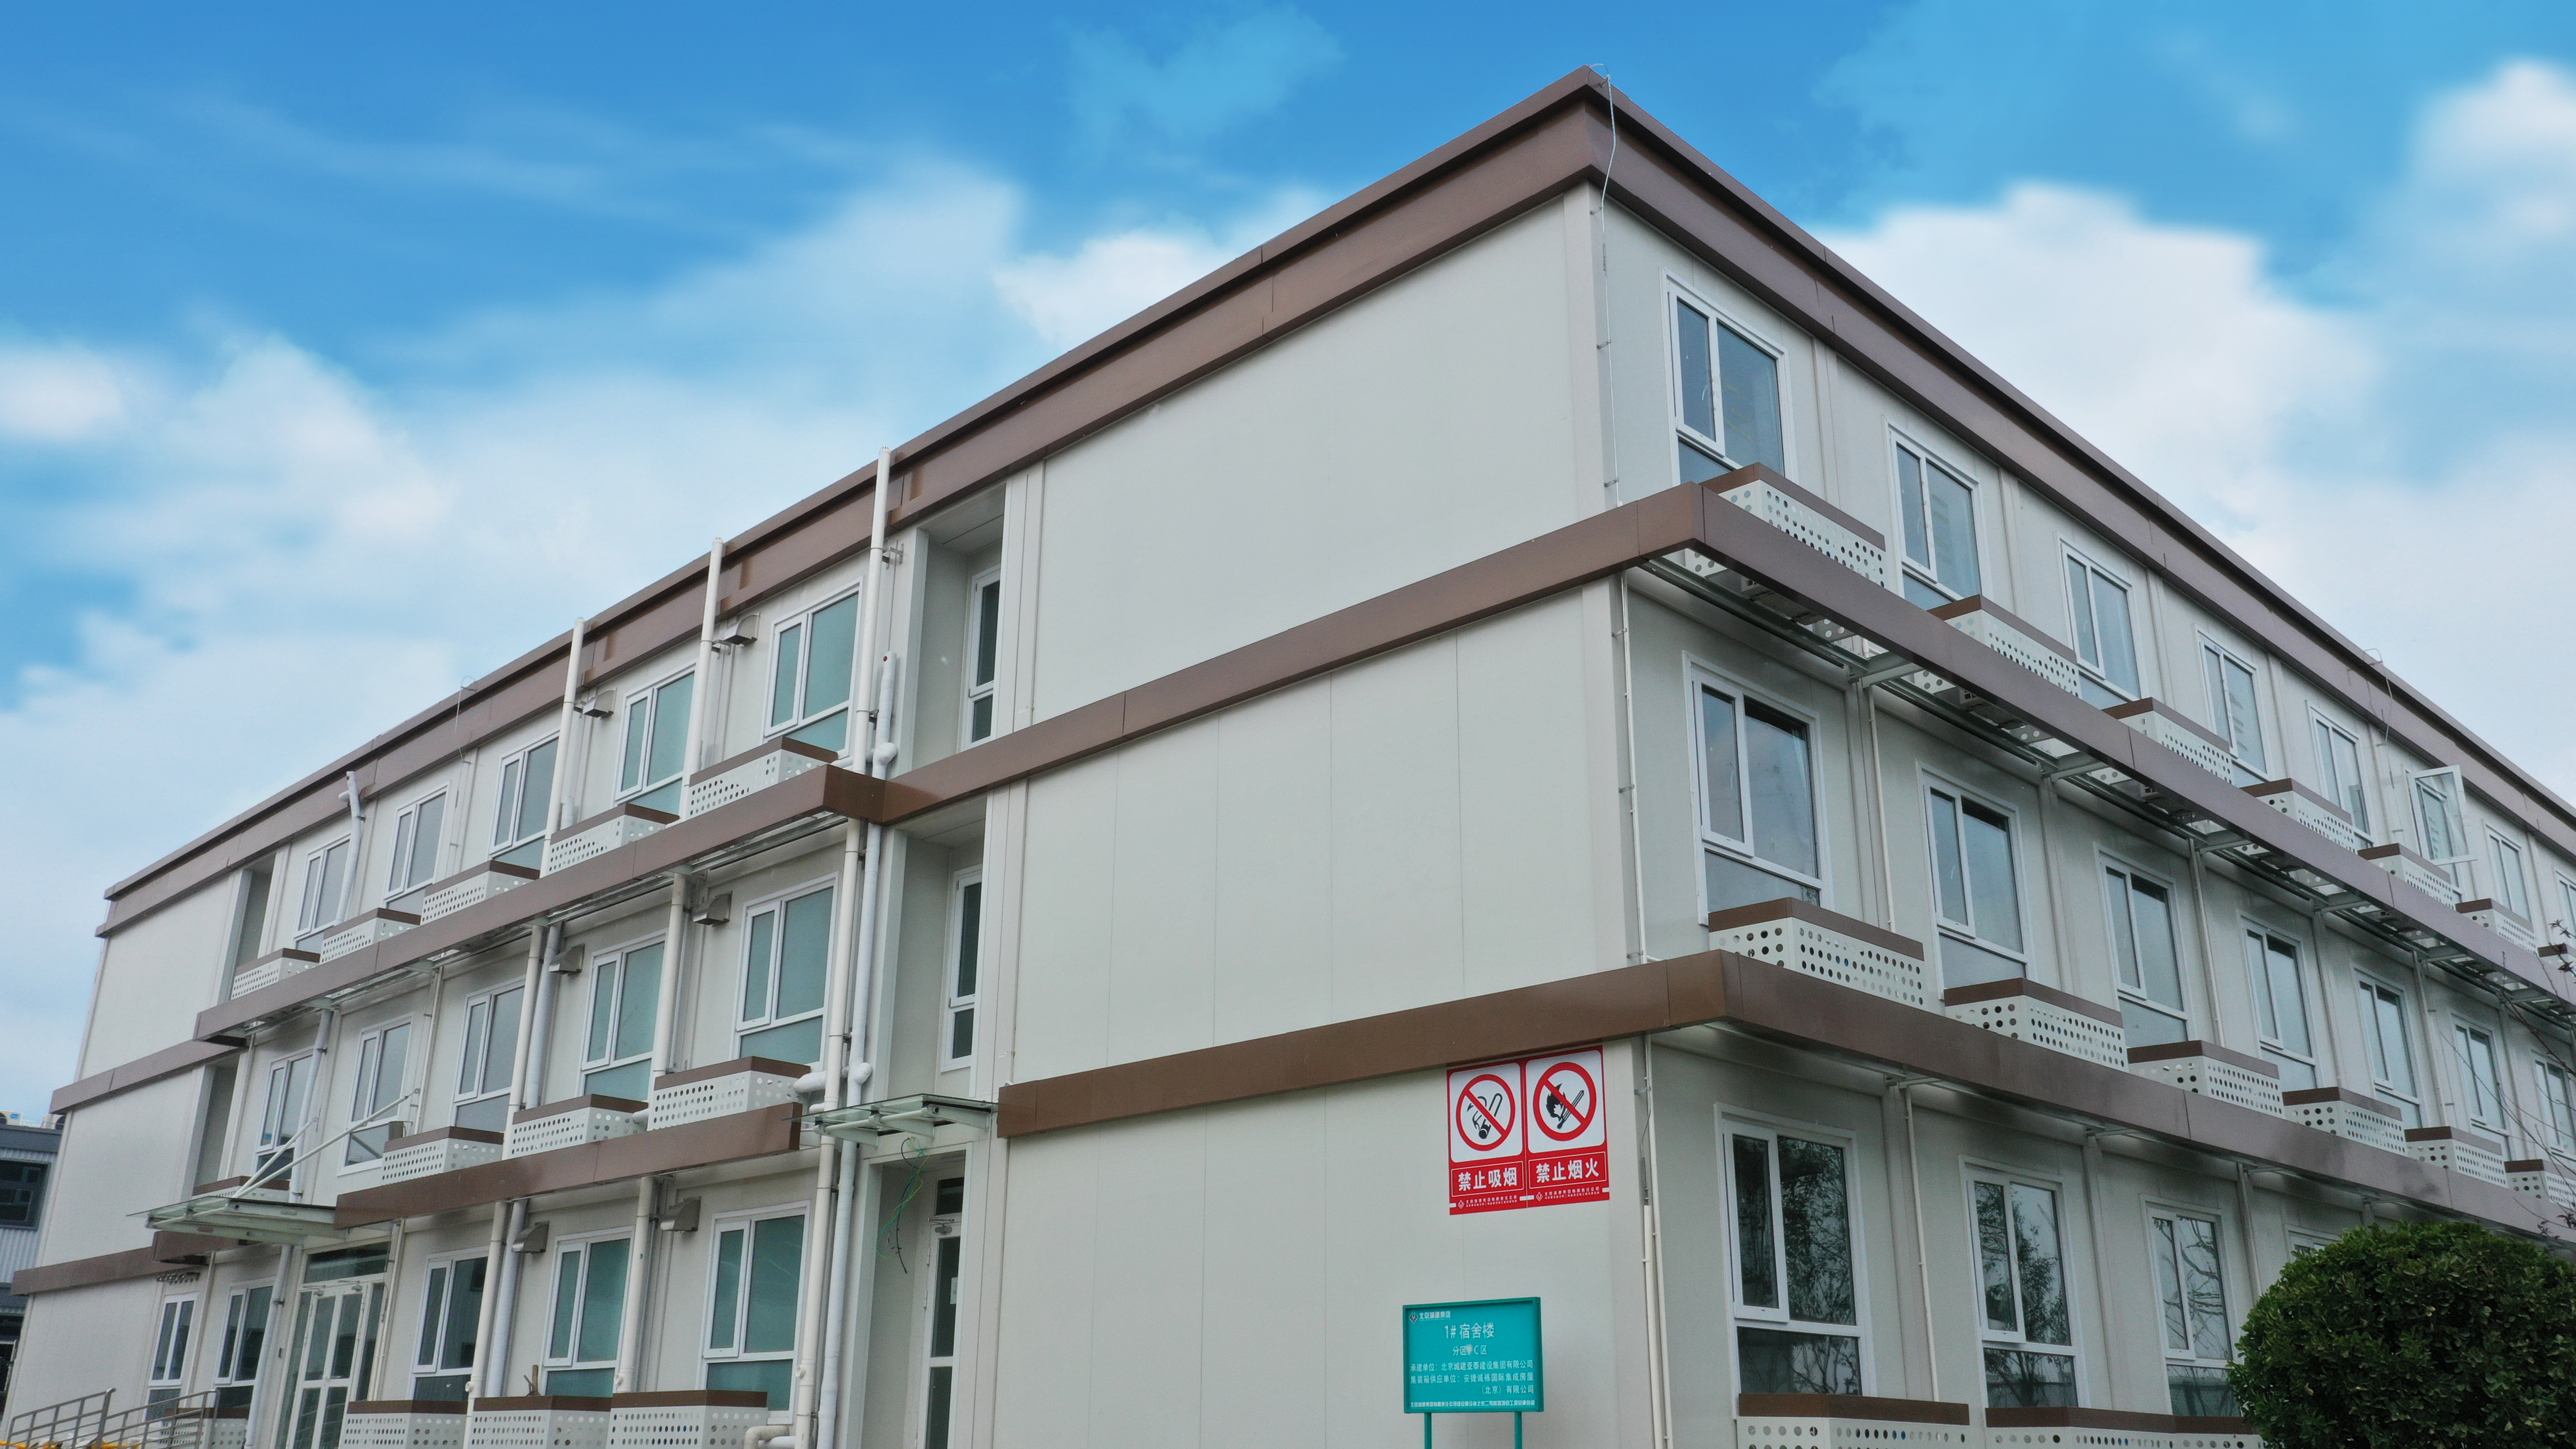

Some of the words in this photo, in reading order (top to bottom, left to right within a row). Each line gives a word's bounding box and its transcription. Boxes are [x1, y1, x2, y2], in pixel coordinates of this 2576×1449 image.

[1458, 1167, 1517, 1191] 禁止吸烟
[1536, 1158, 1599, 1183] 禁止烟火
[1452, 1344, 1487, 1356] 分区C区
